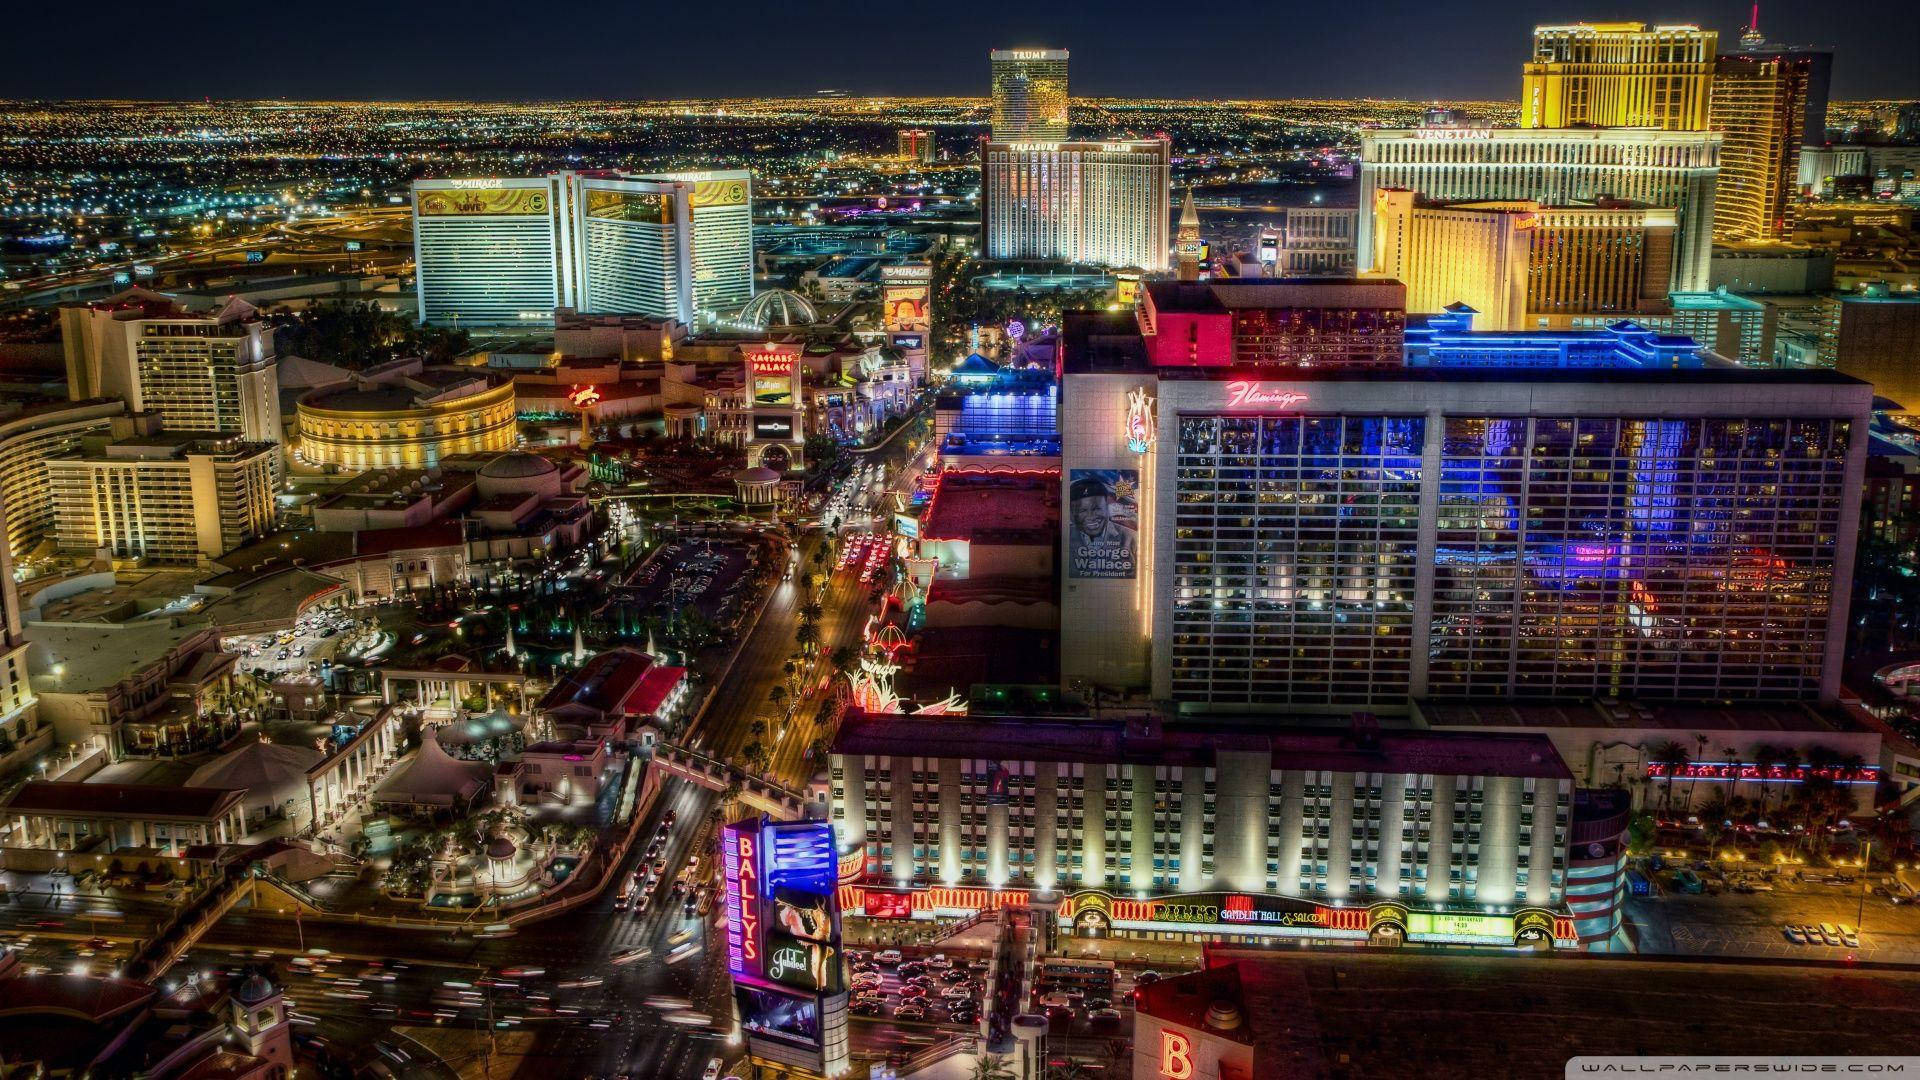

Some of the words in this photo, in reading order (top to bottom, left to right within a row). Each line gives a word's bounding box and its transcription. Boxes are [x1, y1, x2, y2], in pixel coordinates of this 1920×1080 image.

[1417, 130, 1490, 139] VENETIAN
[1010, 143, 1059, 151] TREASURE
[462, 179, 503, 189] MIRAGE
[892, 268, 930, 277] MIRAGE
[750, 354, 793, 362] CAESARS
[753, 363, 791, 371] PALACE
[1225, 381, 1309, 409] Flamingo
[1077, 546, 1130, 560] George
[1074, 558, 1132, 570] Wallace
[1153, 904, 1218, 923] BILL'S
[1261, 911, 1283, 922] HALL
[1292, 912, 1327, 923] SALOON
[1160, 1029, 1193, 1080] B
